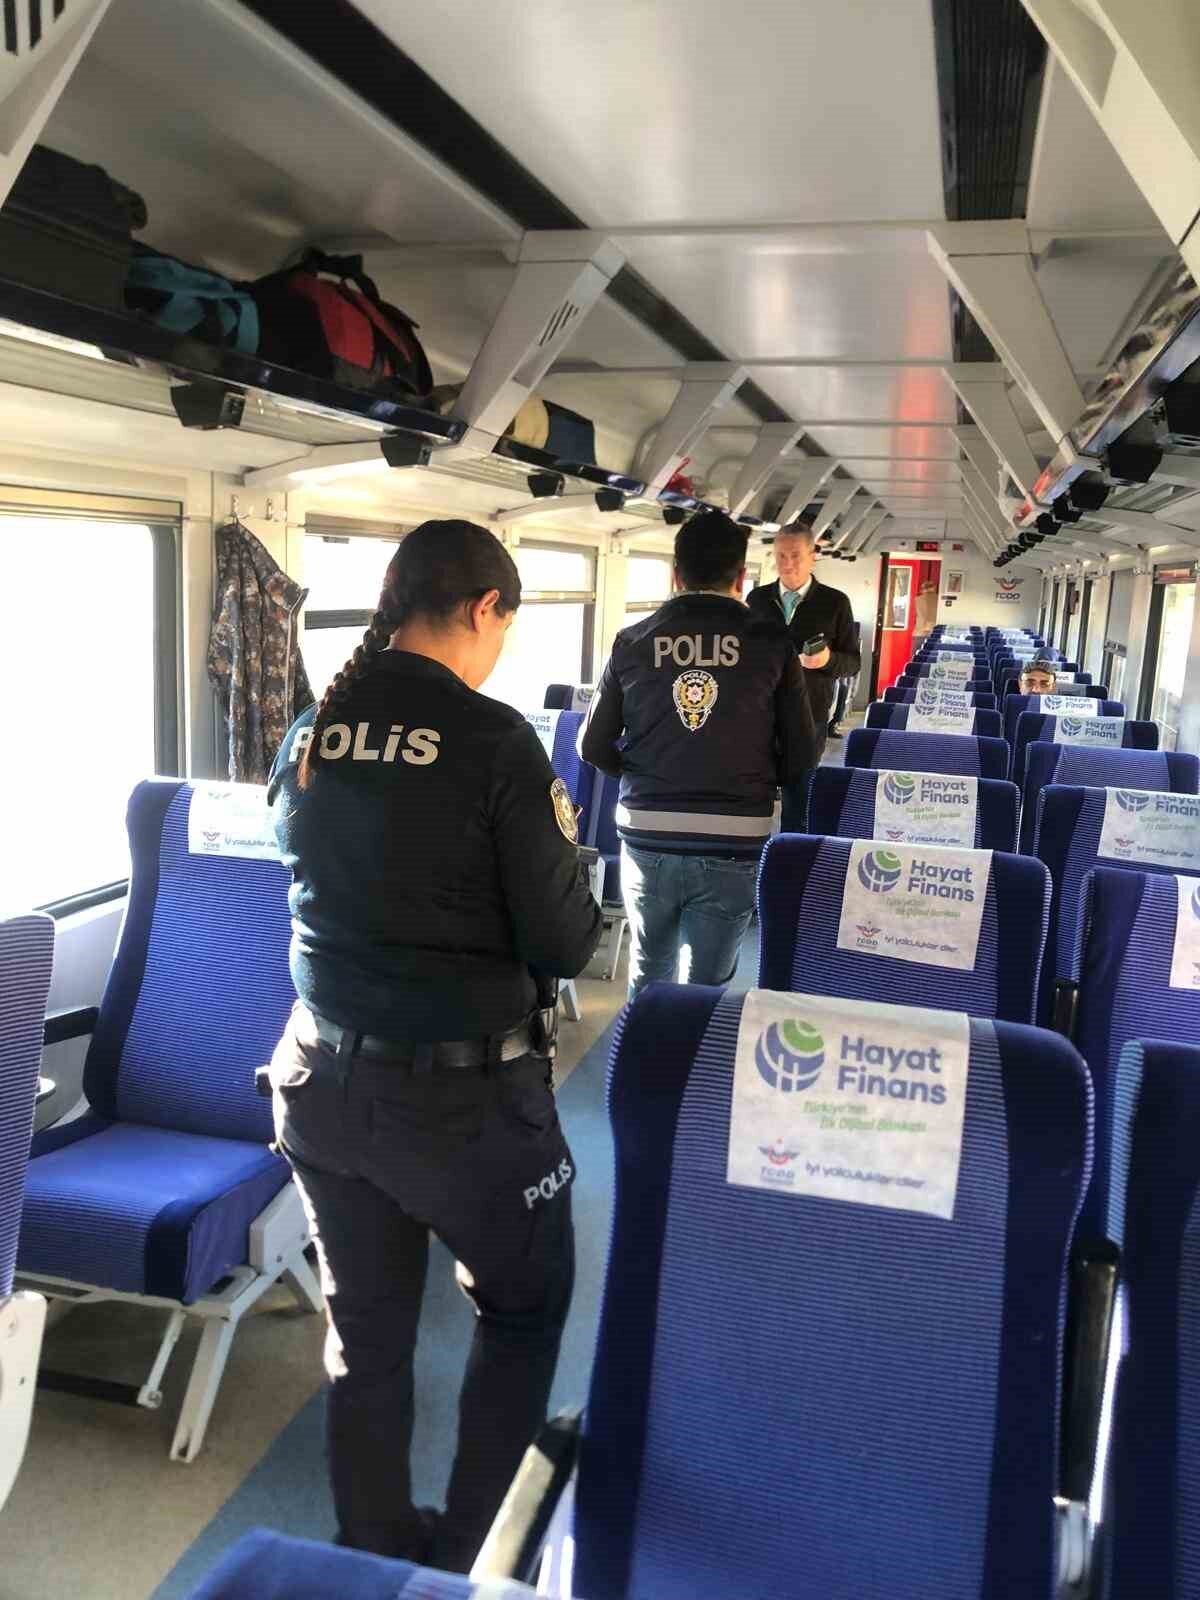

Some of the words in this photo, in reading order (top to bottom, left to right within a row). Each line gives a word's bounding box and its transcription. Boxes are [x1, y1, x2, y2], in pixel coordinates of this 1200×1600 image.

[654, 634, 740, 668] POLIS
[1085, 728, 1118, 739] Finans
[920, 790, 969, 804] Finans
[921, 778, 967, 792] Hayat
[1155, 801, 1200, 817] Finan
[910, 859, 973, 883] Hayat
[907, 877, 975, 902] Finans
[839, 1034, 943, 1074] Hayat
[836, 1064, 947, 1105] Finans
